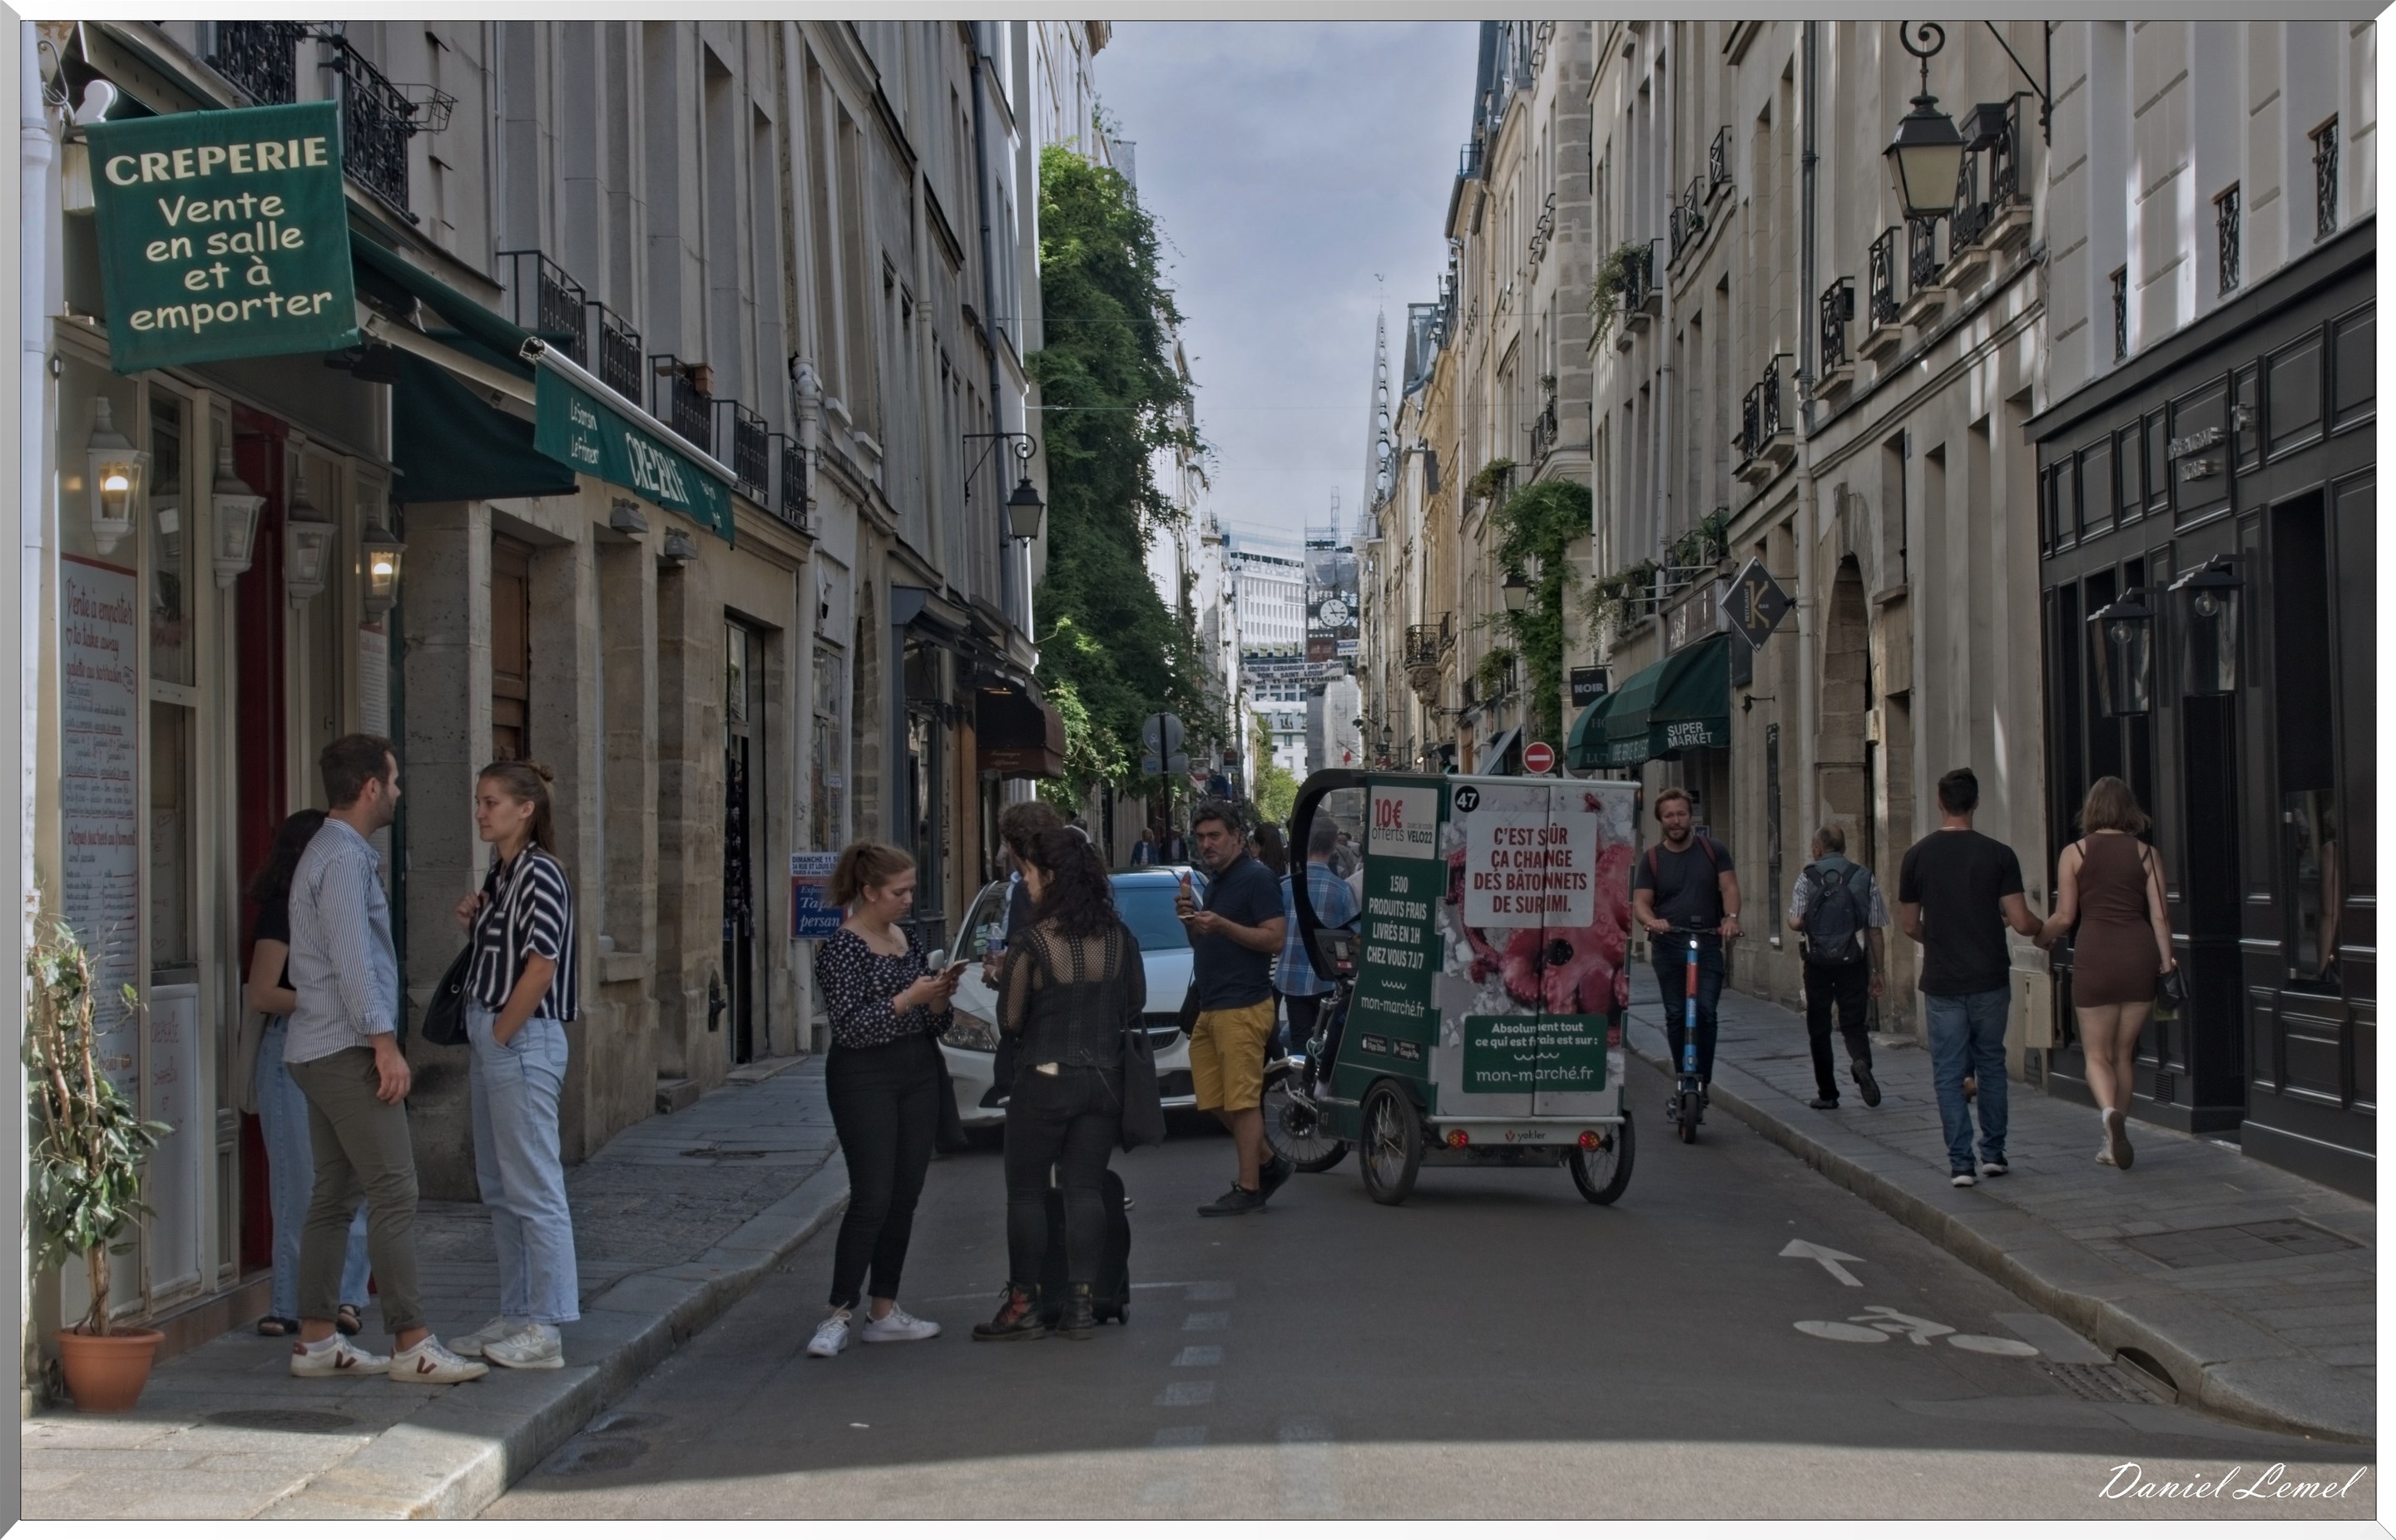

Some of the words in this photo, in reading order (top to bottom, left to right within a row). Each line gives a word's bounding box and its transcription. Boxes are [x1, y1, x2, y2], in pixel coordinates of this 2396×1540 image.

[105, 136, 329, 186] CREPERIE
[158, 191, 285, 227] Vente
[146, 233, 193, 263] en
[206, 221, 304, 256] salle
[184, 260, 230, 292] et
[246, 256, 271, 286] à
[129, 290, 332, 334] emporter
[66, 576, 90, 618] Vente
[98, 592, 134, 633] emporter
[73, 621, 81, 645] to
[82, 624, 99, 649] take
[1288, 676, 1343, 684] SEPTEMBRE
[1574, 682, 1605, 694] NOIR
[1666, 721, 1704, 737] SUPER
[1667, 732, 1713, 749] MARKET
[1457, 793, 1477, 808] 47
[1375, 799, 1403, 829] 10€
[1371, 823, 1404, 842] offerts
[1407, 829, 1433, 844] VELO22
[1493, 826, 1534, 846] C'EST
[1537, 822, 1567, 846] SÛR
[1491, 849, 1509, 872] ÇA
[1513, 849, 1572, 869] CHANGE
[1389, 875, 1408, 894] 1500
[1473, 873, 1502, 890] DES
[1506, 869, 1587, 891] BÂTONNETS
[1369, 897, 1404, 918] PRODUITS
[1405, 901, 1427, 920] FRAIS
[1493, 895, 1512, 914] DE
[1515, 894, 1572, 914] SURIMI.
[1372, 920, 1398, 942] LIVRÉS
[1398, 925, 1409, 943] EN
[1410, 927, 1421, 944] 1H
[1366, 945, 1387, 964] CHEZ
[1387, 948, 1407, 968] VOUS
[1360, 996, 1425, 1018] mon-marché.fr
[1491, 1022, 1559, 1034] Absolument
[1560, 1022, 1584, 1032] tout
[1475, 1038, 1488, 1047] ce
[1490, 1037, 1507, 1048] qui
[1509, 1037, 1527, 1047] est
[1528, 1034, 1555, 1047] frais
[1557, 1036, 1573, 1045] est
[1574, 1037, 1593, 1045] sur
[1476, 1066, 1594, 1082] mon-marché.fr
[1517, 1130, 1547, 1142] yokler
